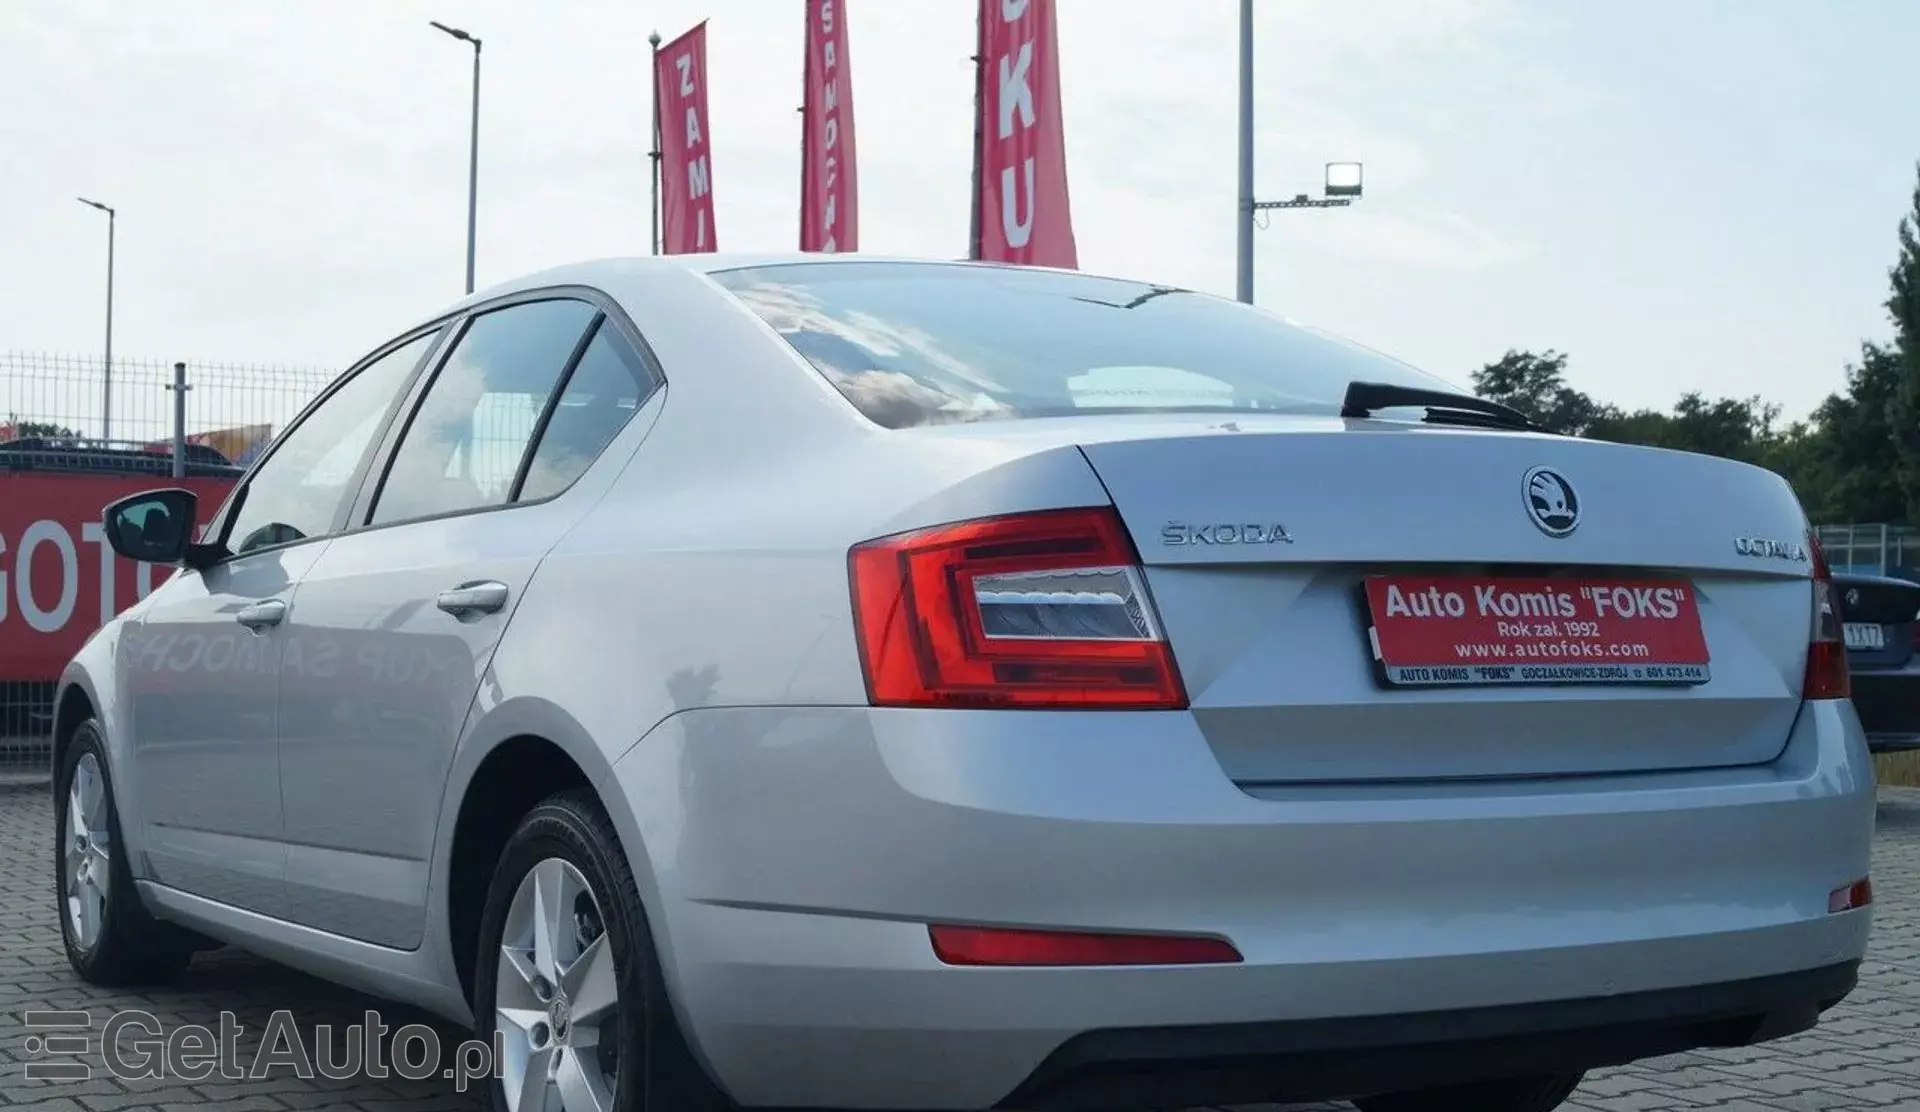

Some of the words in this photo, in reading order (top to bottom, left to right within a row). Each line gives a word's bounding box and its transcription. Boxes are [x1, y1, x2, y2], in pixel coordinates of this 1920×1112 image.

[676, 53, 709, 247] ZAMI
[1161, 520, 1294, 546] ŠKODA
[1386, 584, 1465, 617] Auto
[1473, 584, 1576, 617] Komis
[1580, 586, 1685, 619] "FOKS"
[1497, 621, 1531, 637] Rok
[1564, 621, 1600, 637] 1992
[1455, 640, 1649, 657] www.autofoks.com
[1399, 667, 1430, 681] AUTO
[1432, 667, 1469, 680] KOMIS
